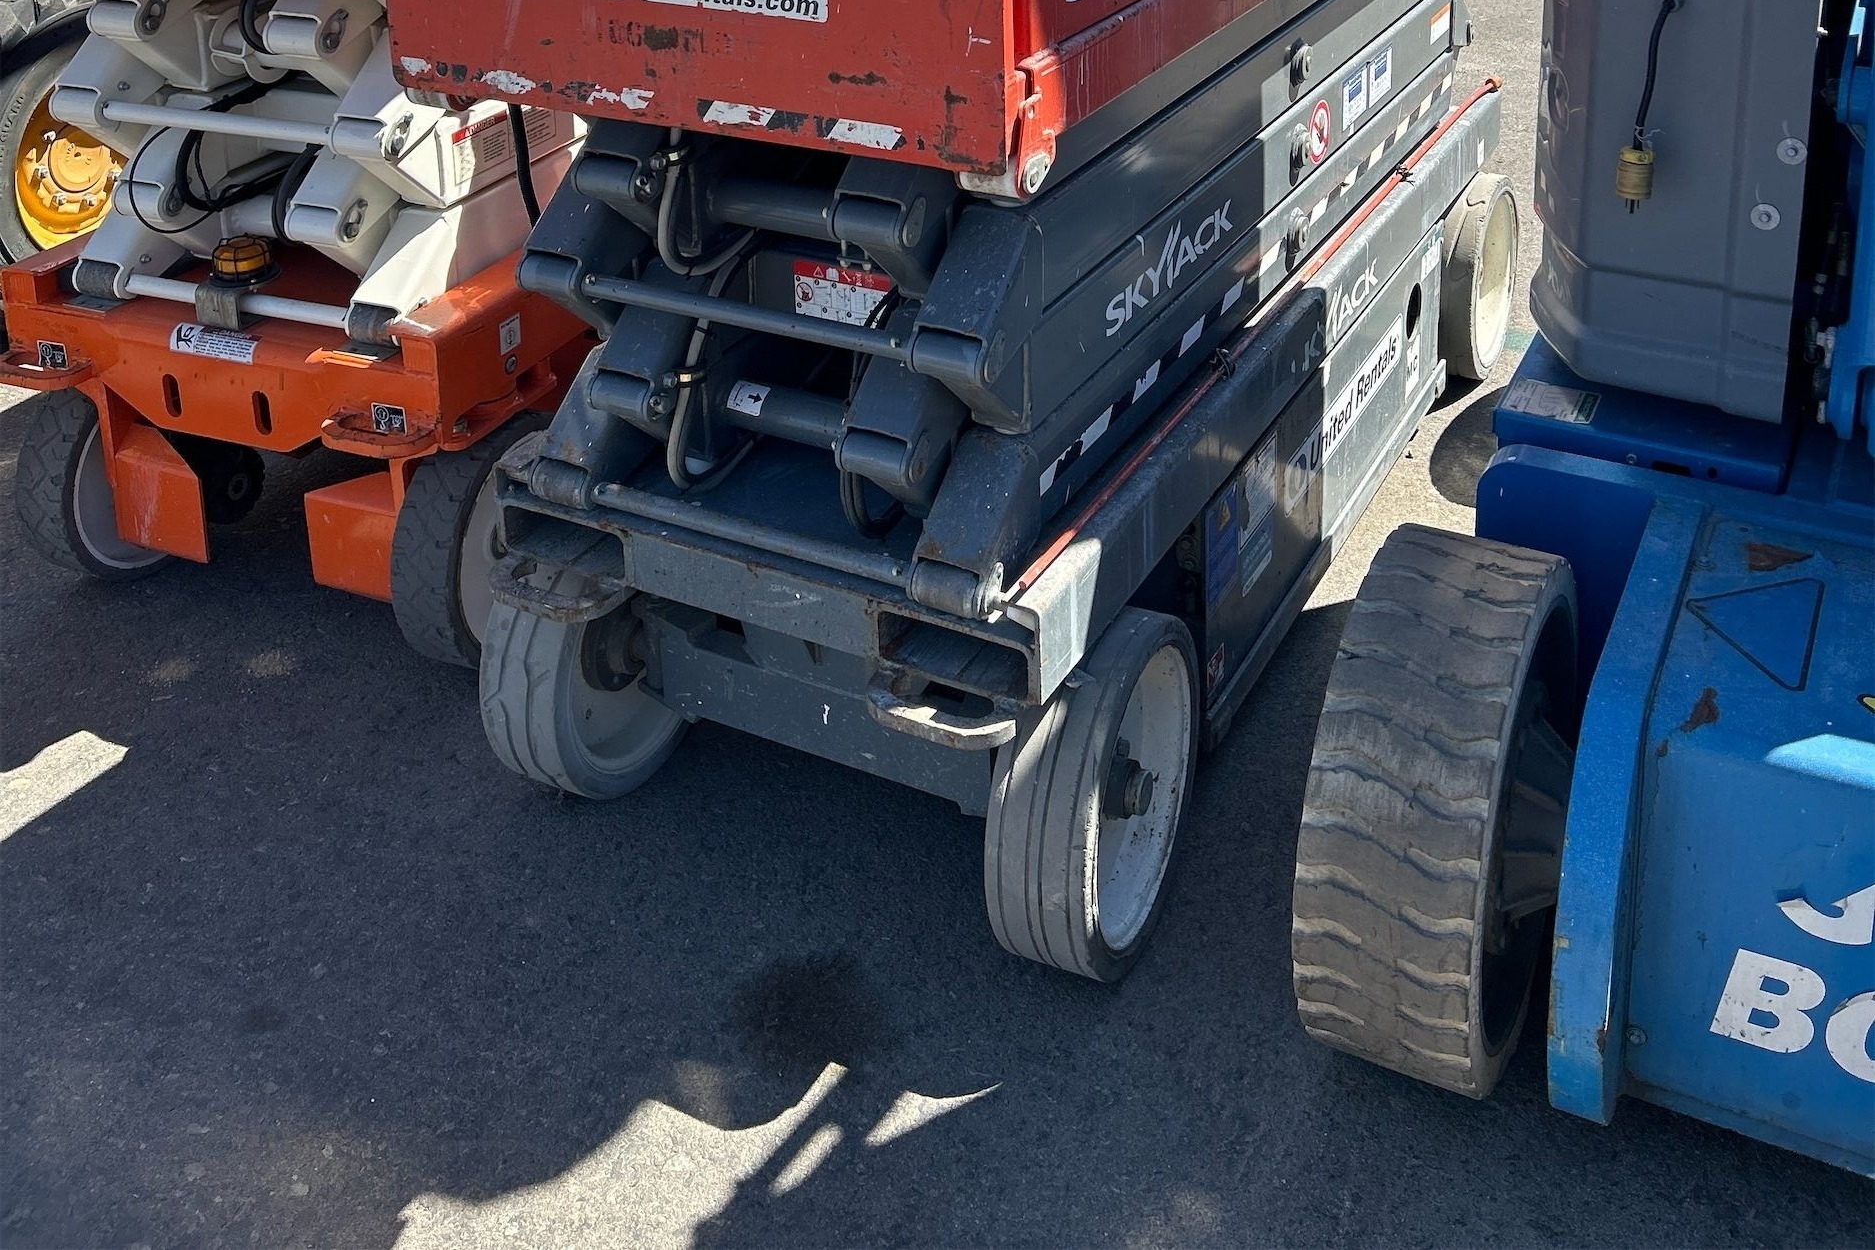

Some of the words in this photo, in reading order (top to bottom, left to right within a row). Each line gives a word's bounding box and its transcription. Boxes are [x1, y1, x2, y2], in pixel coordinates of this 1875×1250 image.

[1105, 198, 1234, 338] SKYJACK
[1291, 257, 1379, 373] KYJACK
[1310, 387, 1354, 471] United
[1355, 333, 1398, 410] Rentals
